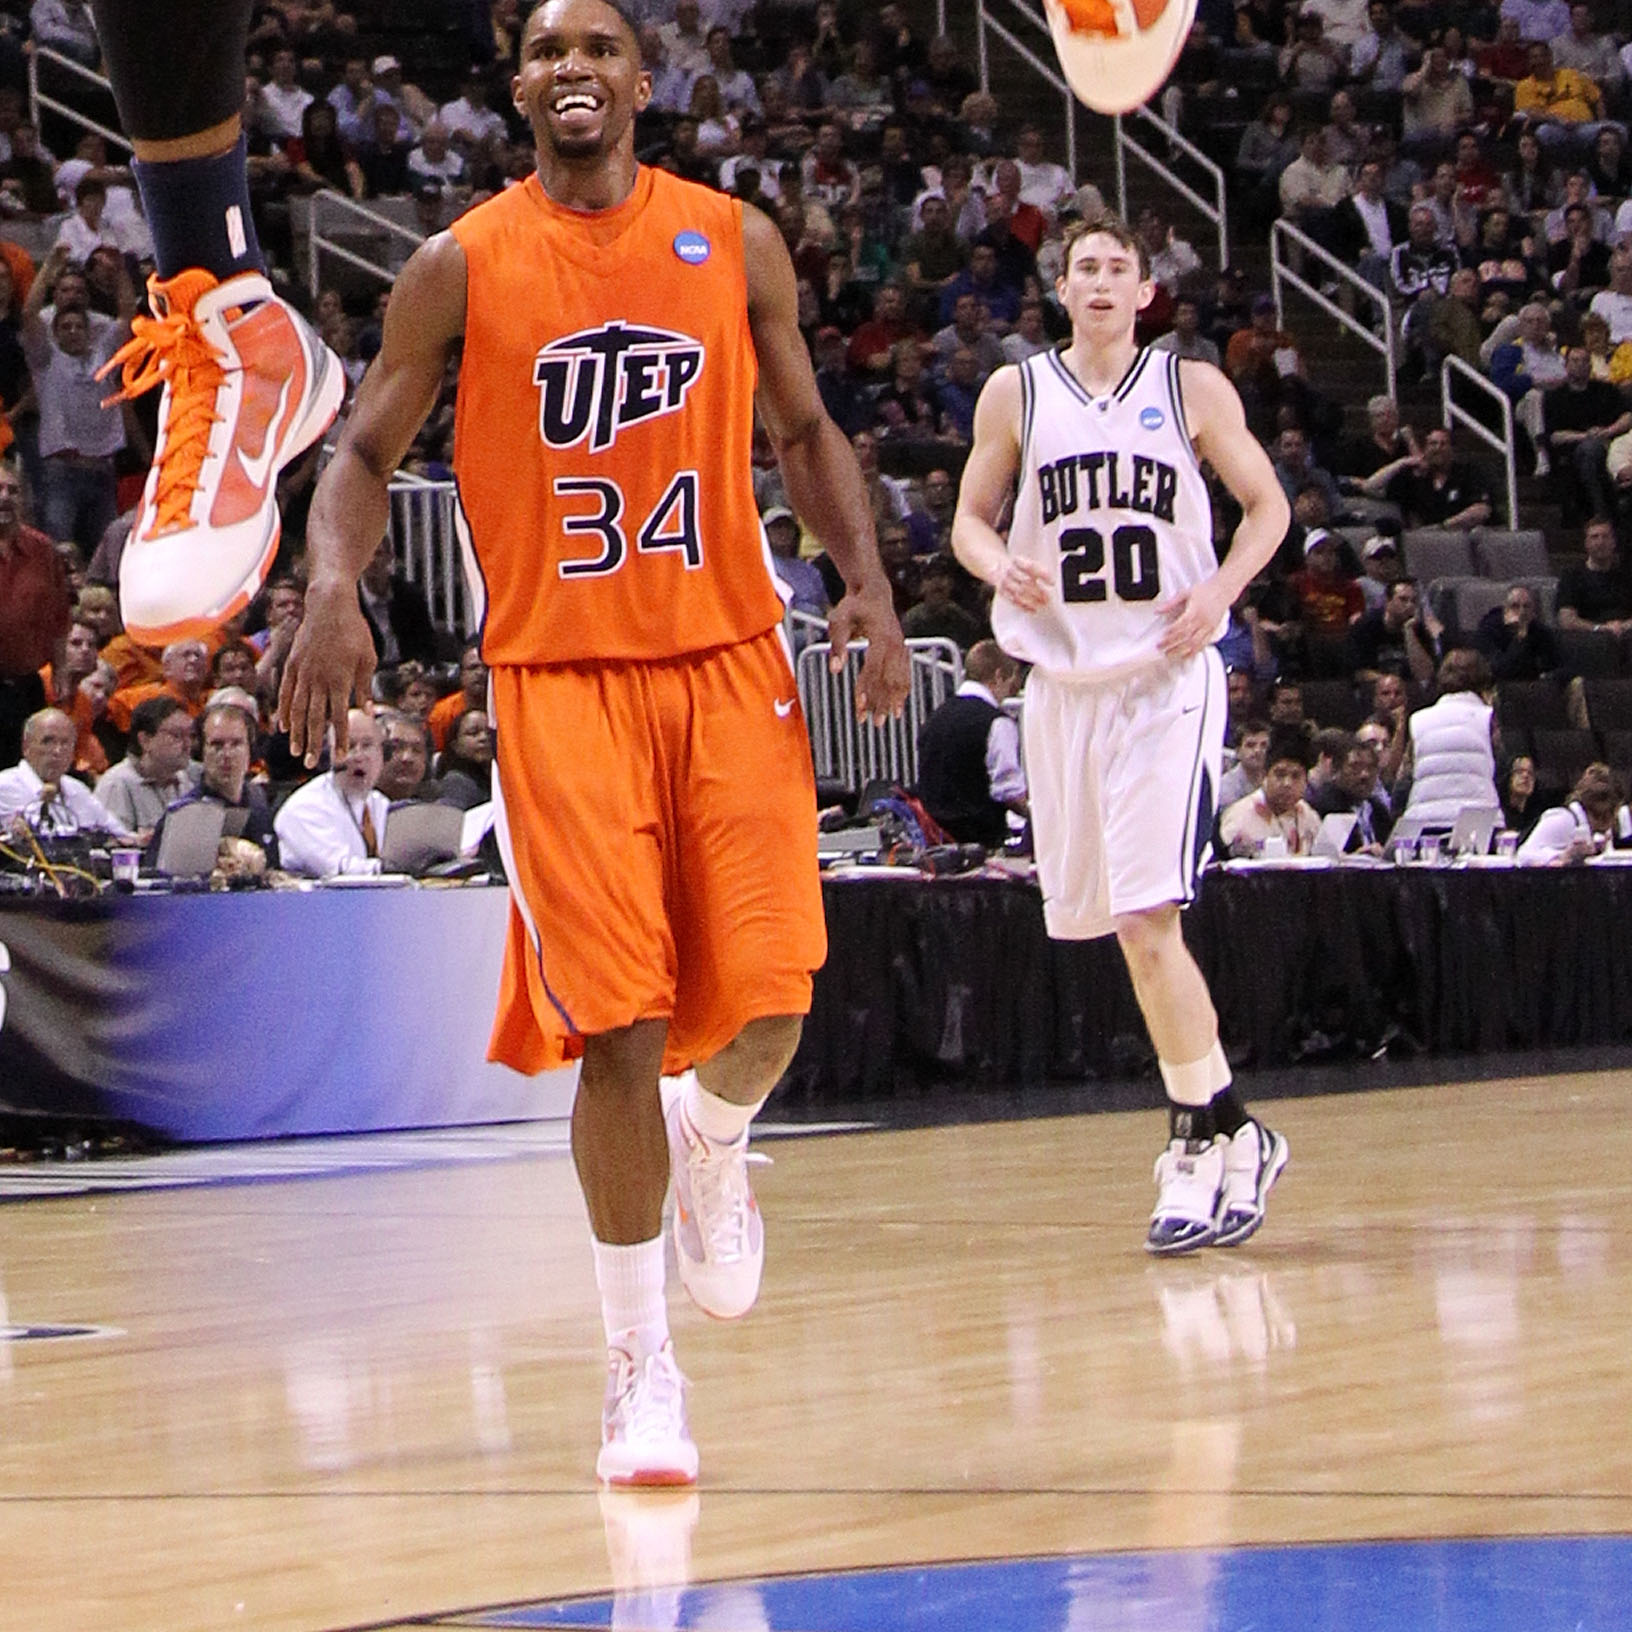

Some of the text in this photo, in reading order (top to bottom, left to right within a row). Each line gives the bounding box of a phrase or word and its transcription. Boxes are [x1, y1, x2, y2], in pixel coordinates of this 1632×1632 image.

[533, 320, 705, 455] UTEP
[553, 470, 705, 580] 34
[1037, 451, 1178, 526] BUTLER
[1059, 525, 1161, 603] 20
